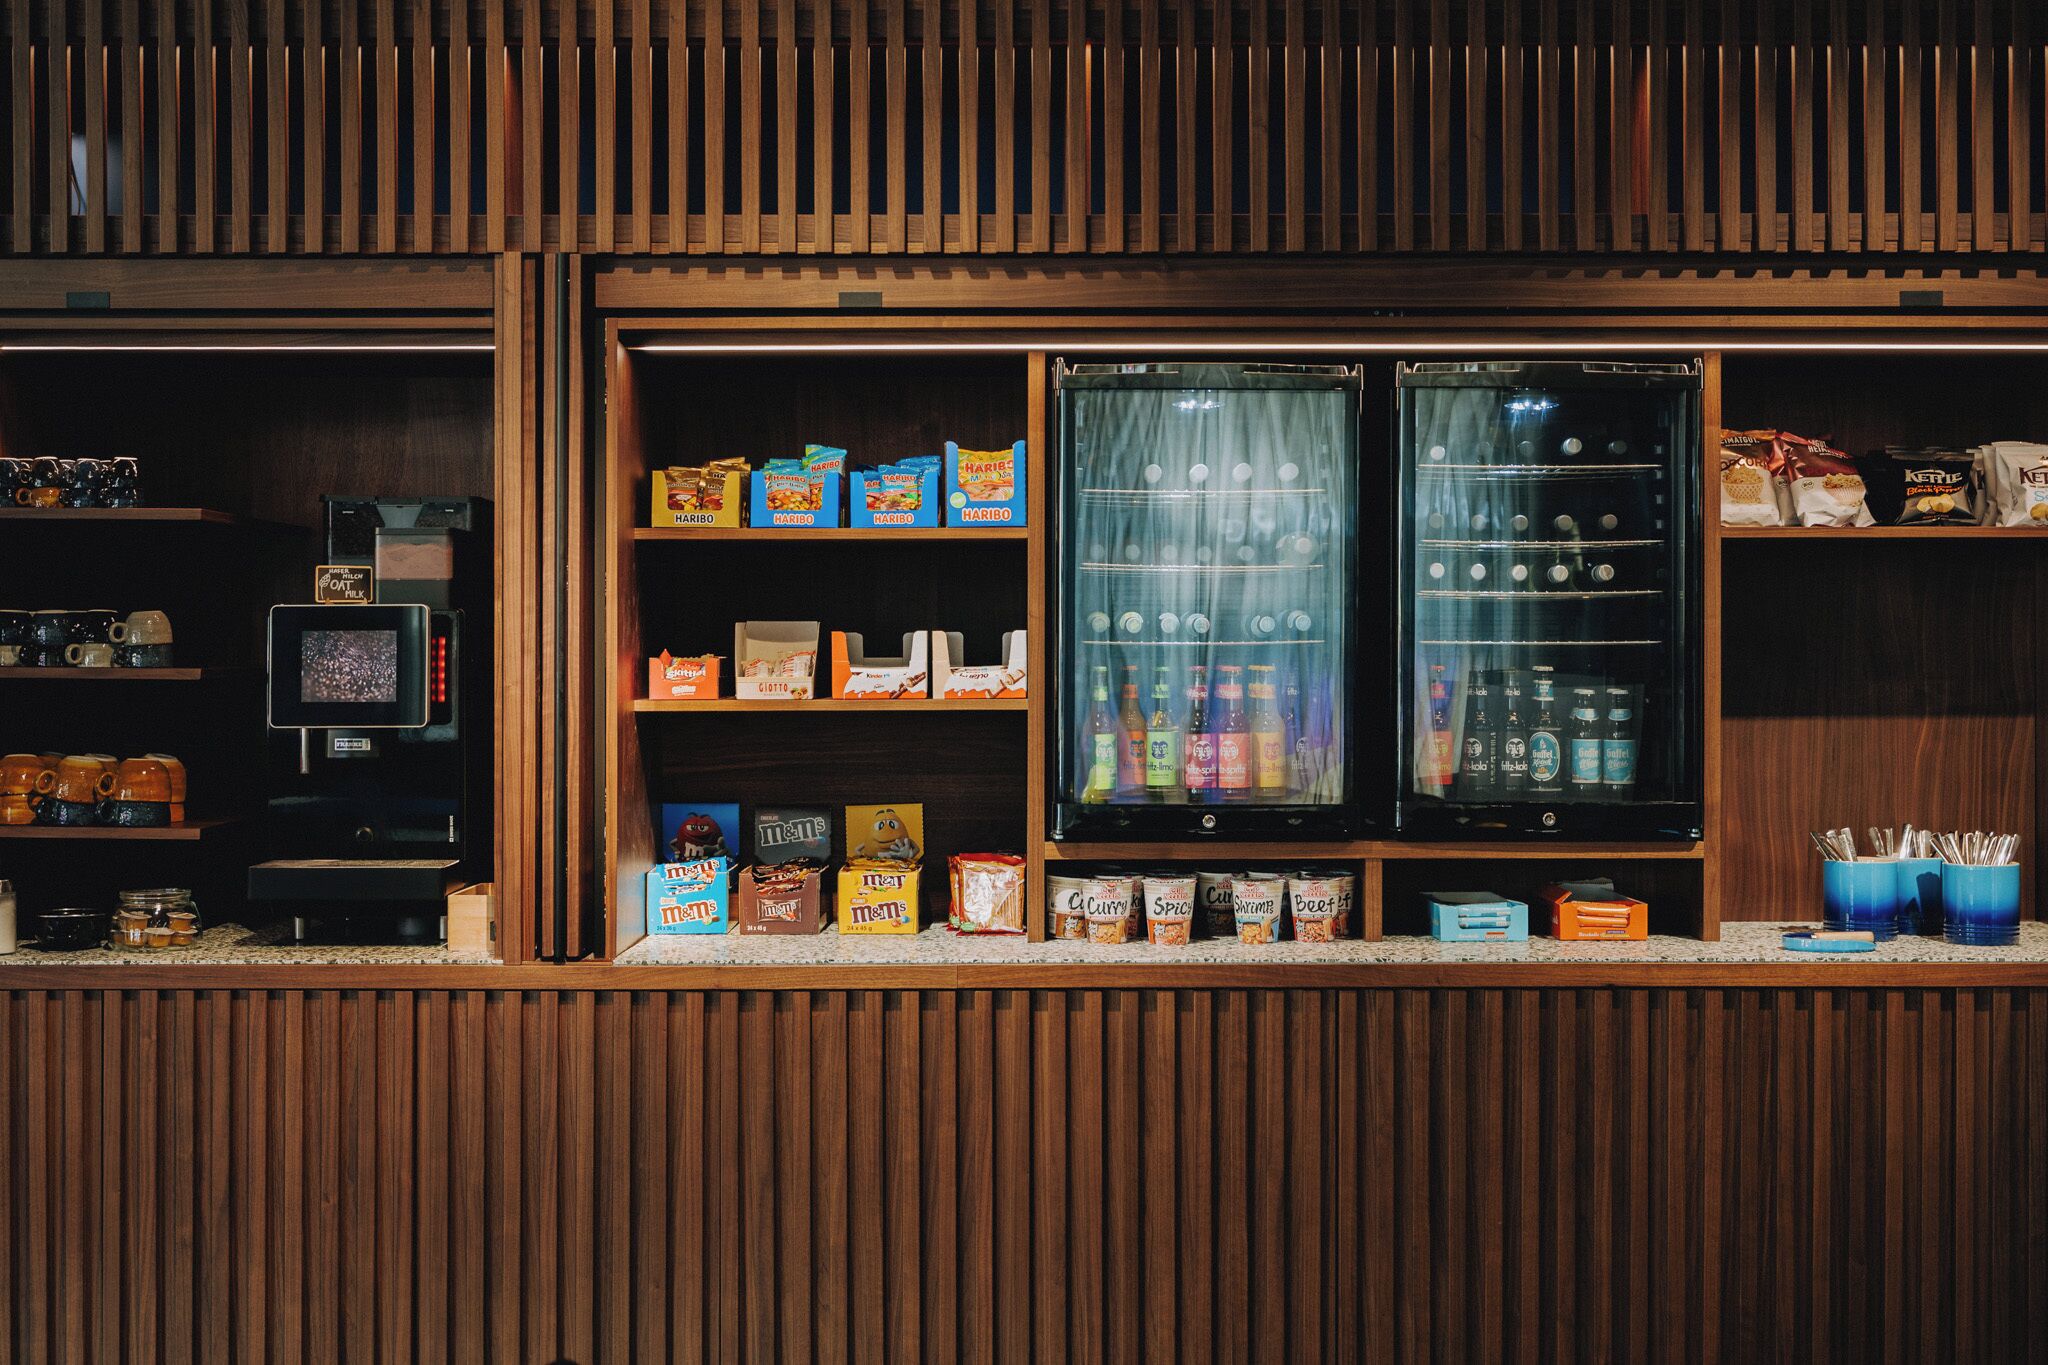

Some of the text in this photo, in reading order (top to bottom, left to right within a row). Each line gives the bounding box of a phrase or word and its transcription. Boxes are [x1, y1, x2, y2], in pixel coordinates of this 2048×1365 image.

[811, 460, 840, 472] HARIBO
[773, 475, 806, 483] HARIBO
[674, 514, 714, 524] HARIBO
[774, 514, 814, 524] HARIBO
[874, 514, 914, 524] HARIBO
[962, 508, 1011, 521] HARIBO
[330, 579, 354, 591] OAT
[345, 590, 365, 599] MILK
[758, 682, 788, 692] GIOTTO
[1087, 896, 1128, 915] Curry
[1295, 894, 1335, 913] Beef
